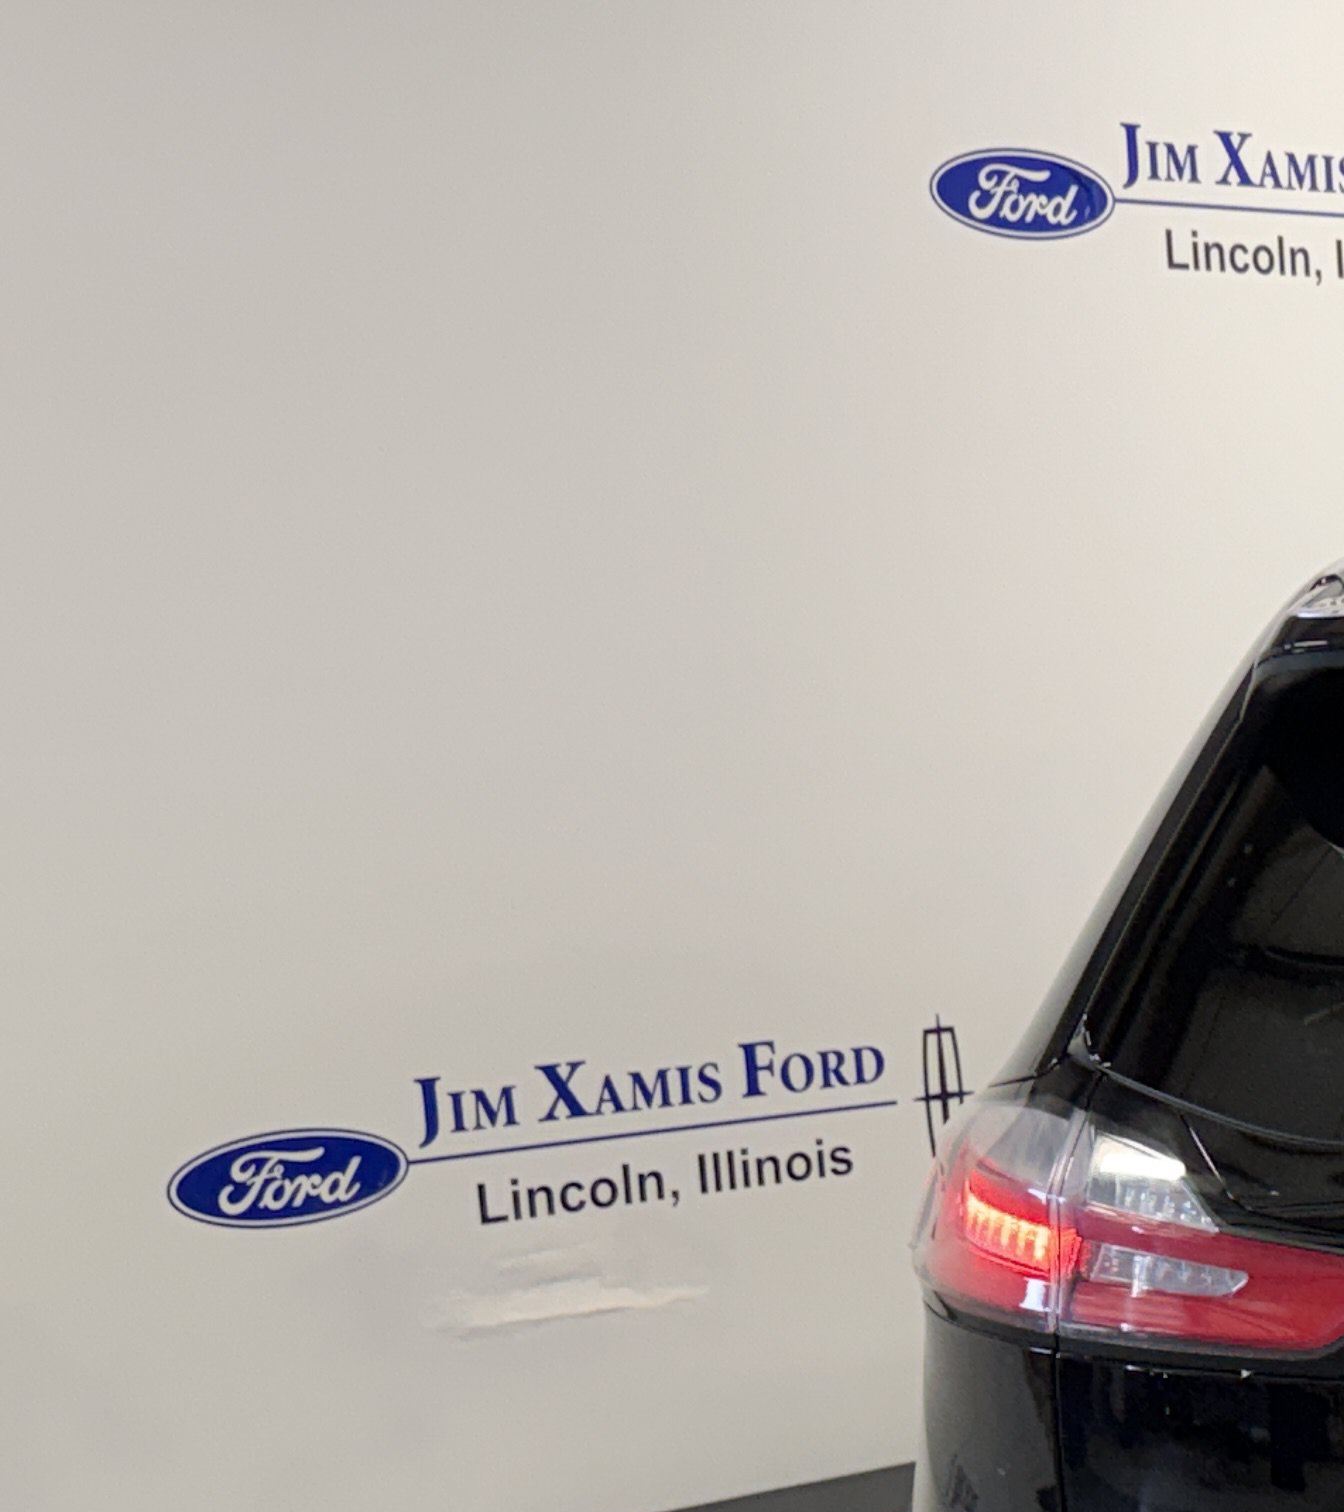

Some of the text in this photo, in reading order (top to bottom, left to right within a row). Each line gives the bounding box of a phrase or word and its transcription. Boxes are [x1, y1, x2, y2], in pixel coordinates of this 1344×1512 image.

[1120, 121, 1201, 190] JIM
[968, 162, 1078, 227] Ford
[1165, 227, 1324, 286] Lincoln,
[413, 1039, 886, 1149] JIM XAMIS FORD
[217, 1147, 361, 1216] Ford
[478, 1138, 856, 1226] Lincoln, Illinois
